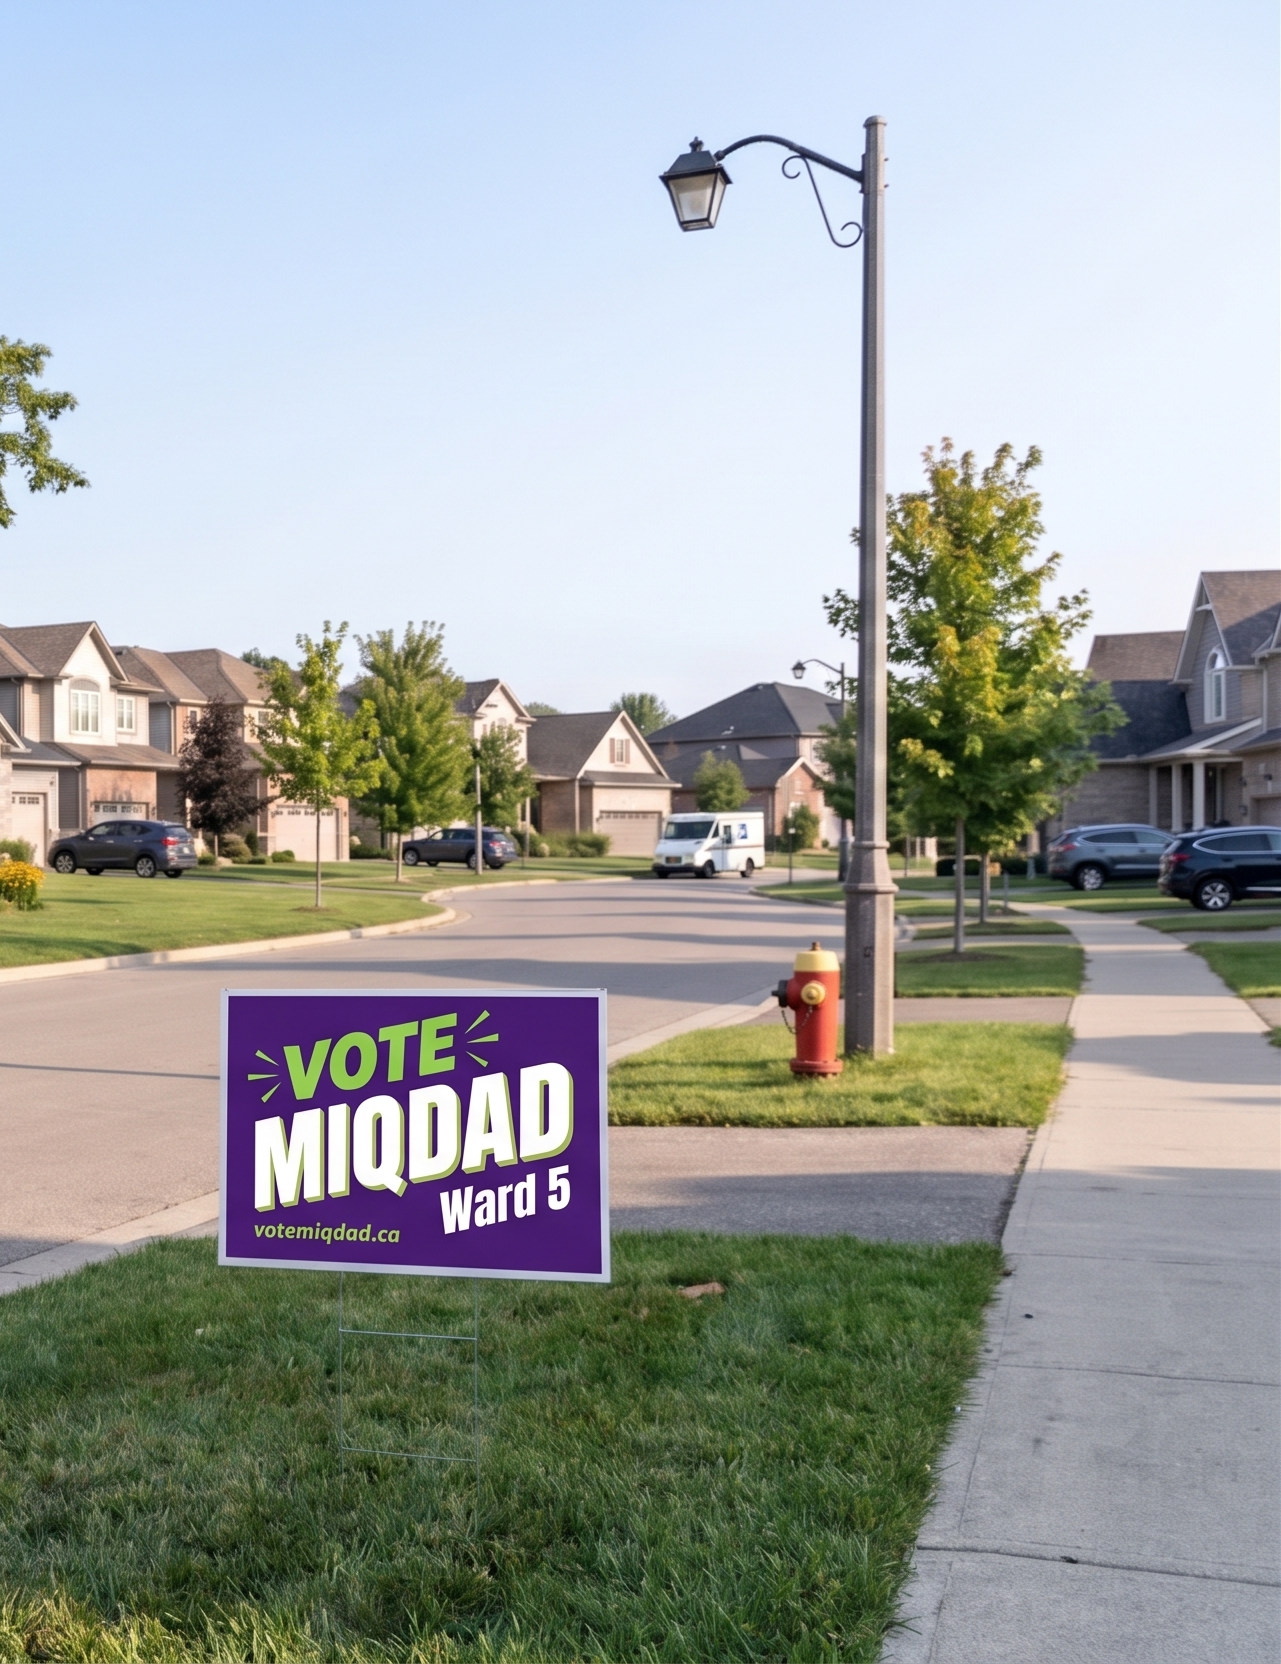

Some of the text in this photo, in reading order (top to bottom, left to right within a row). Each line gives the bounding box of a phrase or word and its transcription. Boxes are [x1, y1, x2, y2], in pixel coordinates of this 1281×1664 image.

[283, 1012, 458, 1101] VOTE
[254, 1062, 574, 1213] MIQDAD
[254, 1222, 400, 1245] votemiqdad.ca
[439, 1164, 571, 1235] Ward 5
